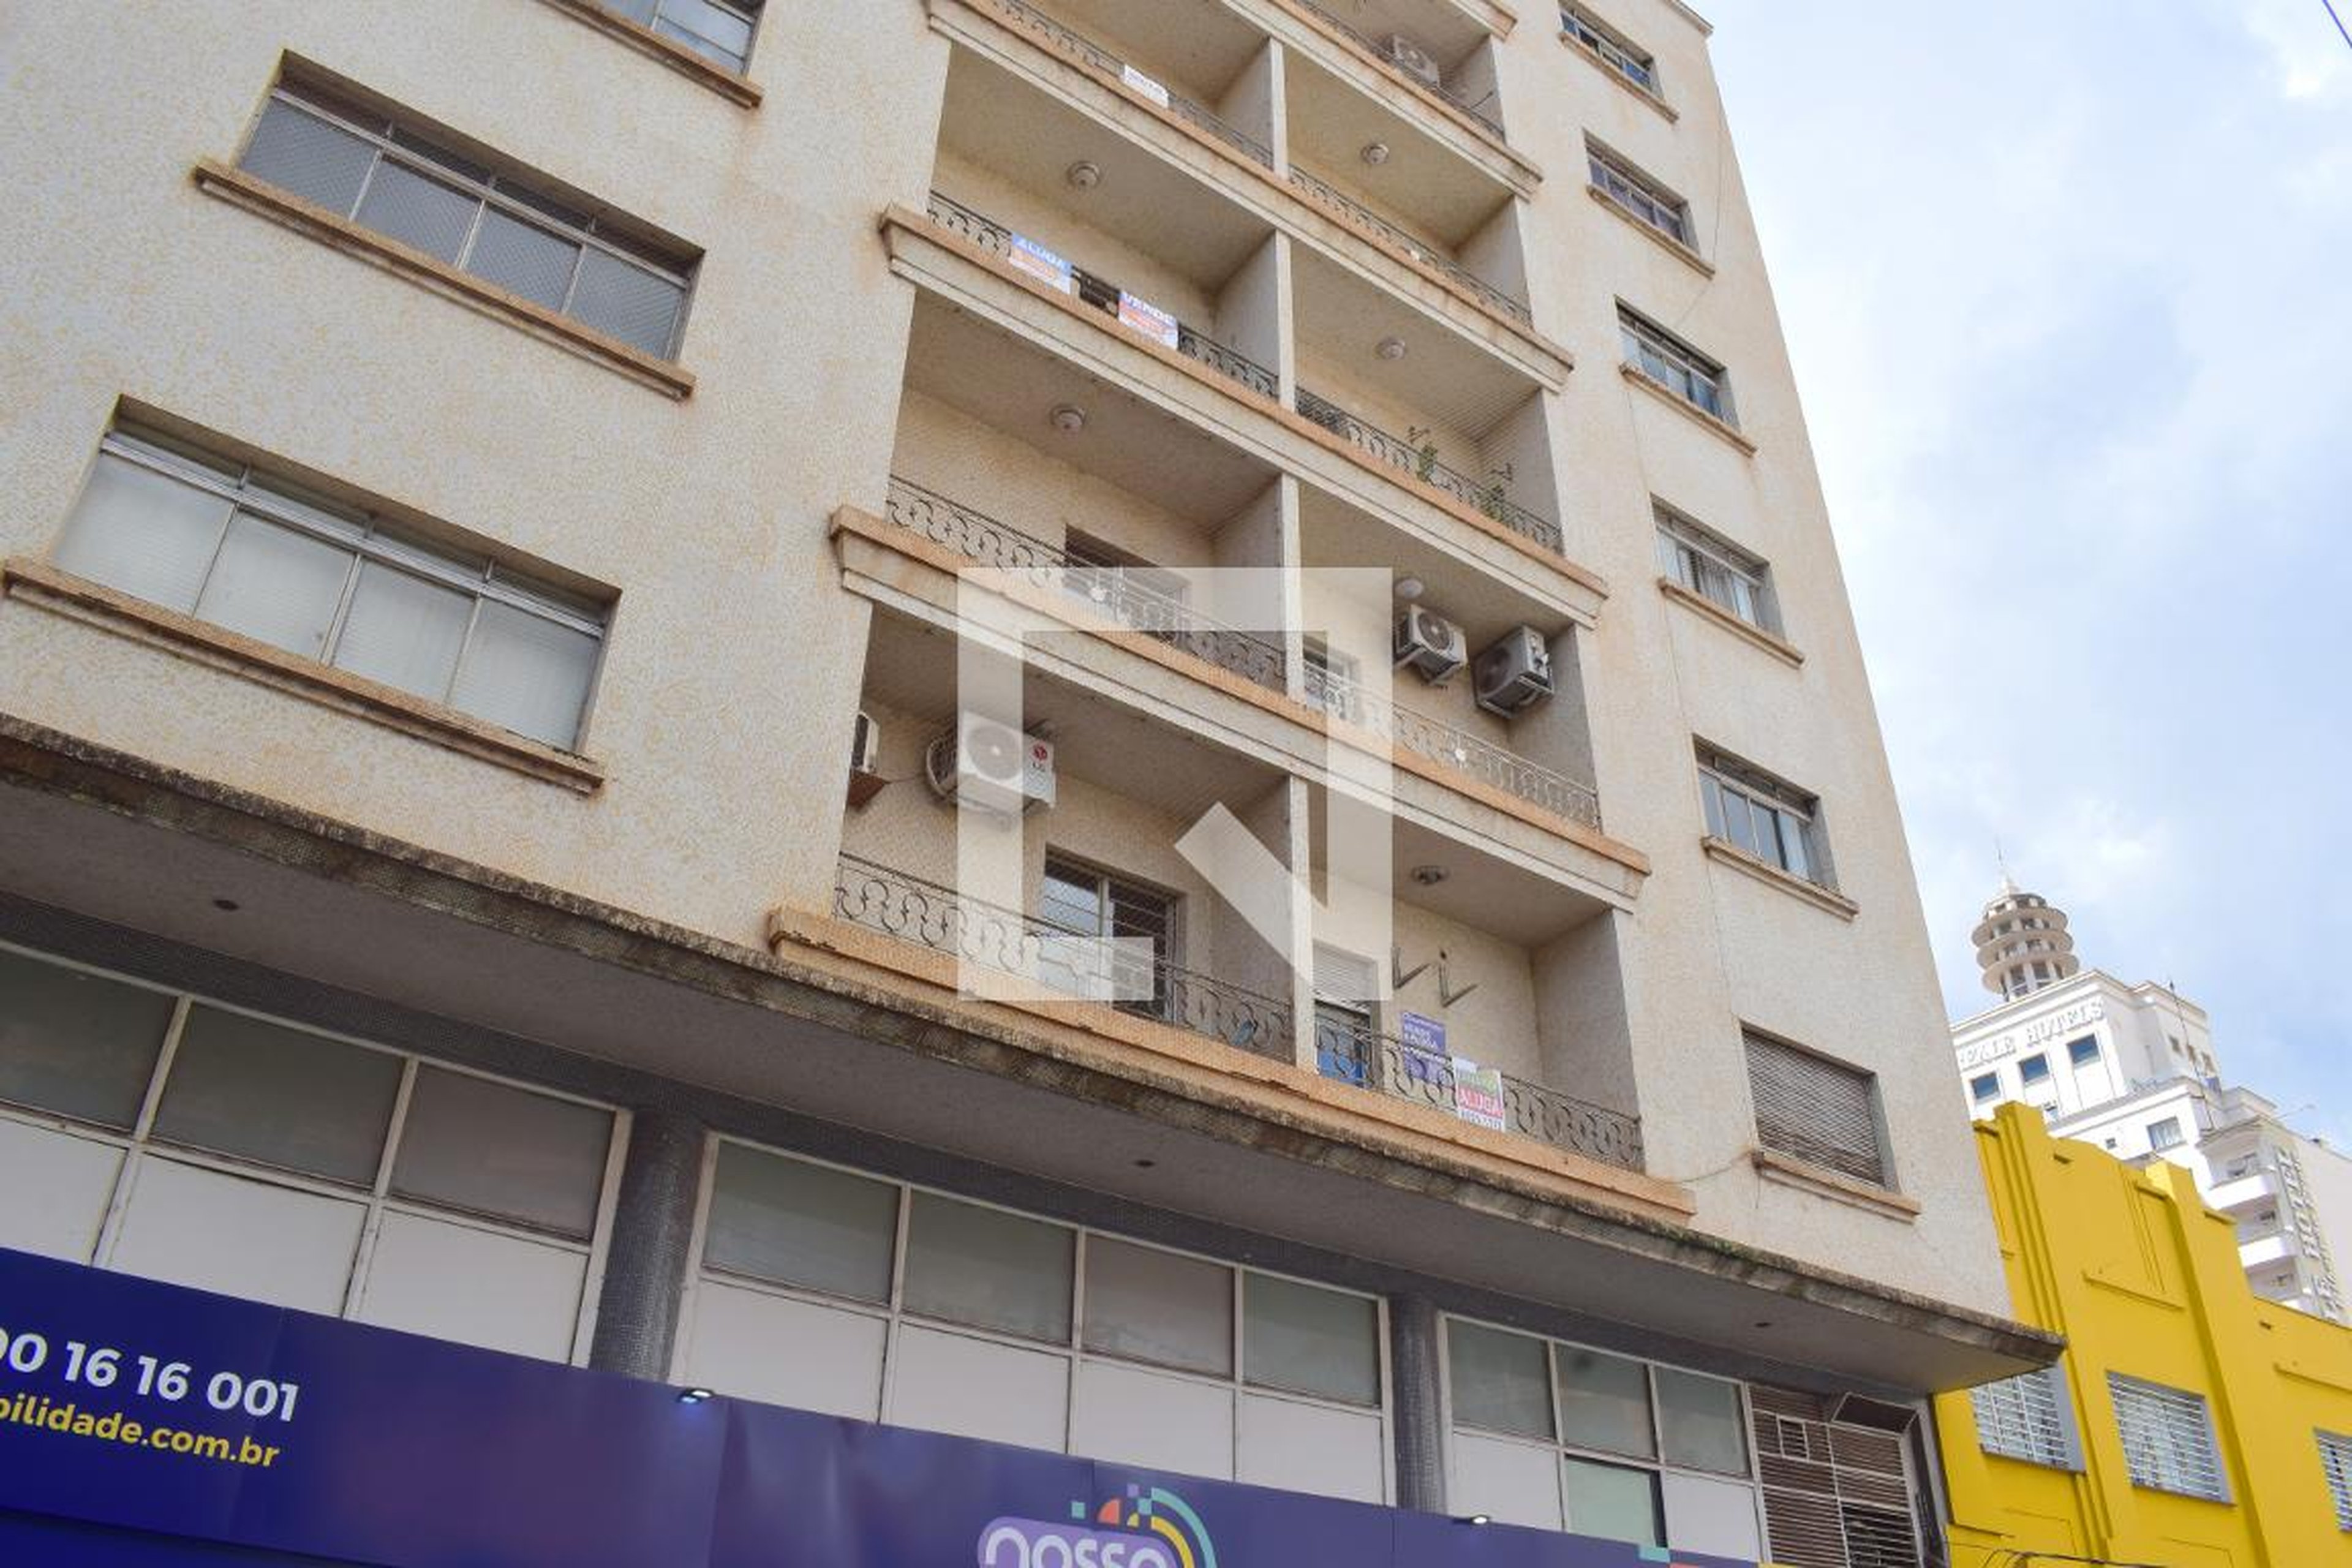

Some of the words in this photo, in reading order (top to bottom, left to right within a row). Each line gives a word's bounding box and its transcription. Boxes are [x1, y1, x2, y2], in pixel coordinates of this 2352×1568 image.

[0, 1327, 48, 1373] 0
[65, 1341, 122, 1387] 16
[137, 1355, 192, 1401] 16
[206, 1371, 299, 1422] 001
